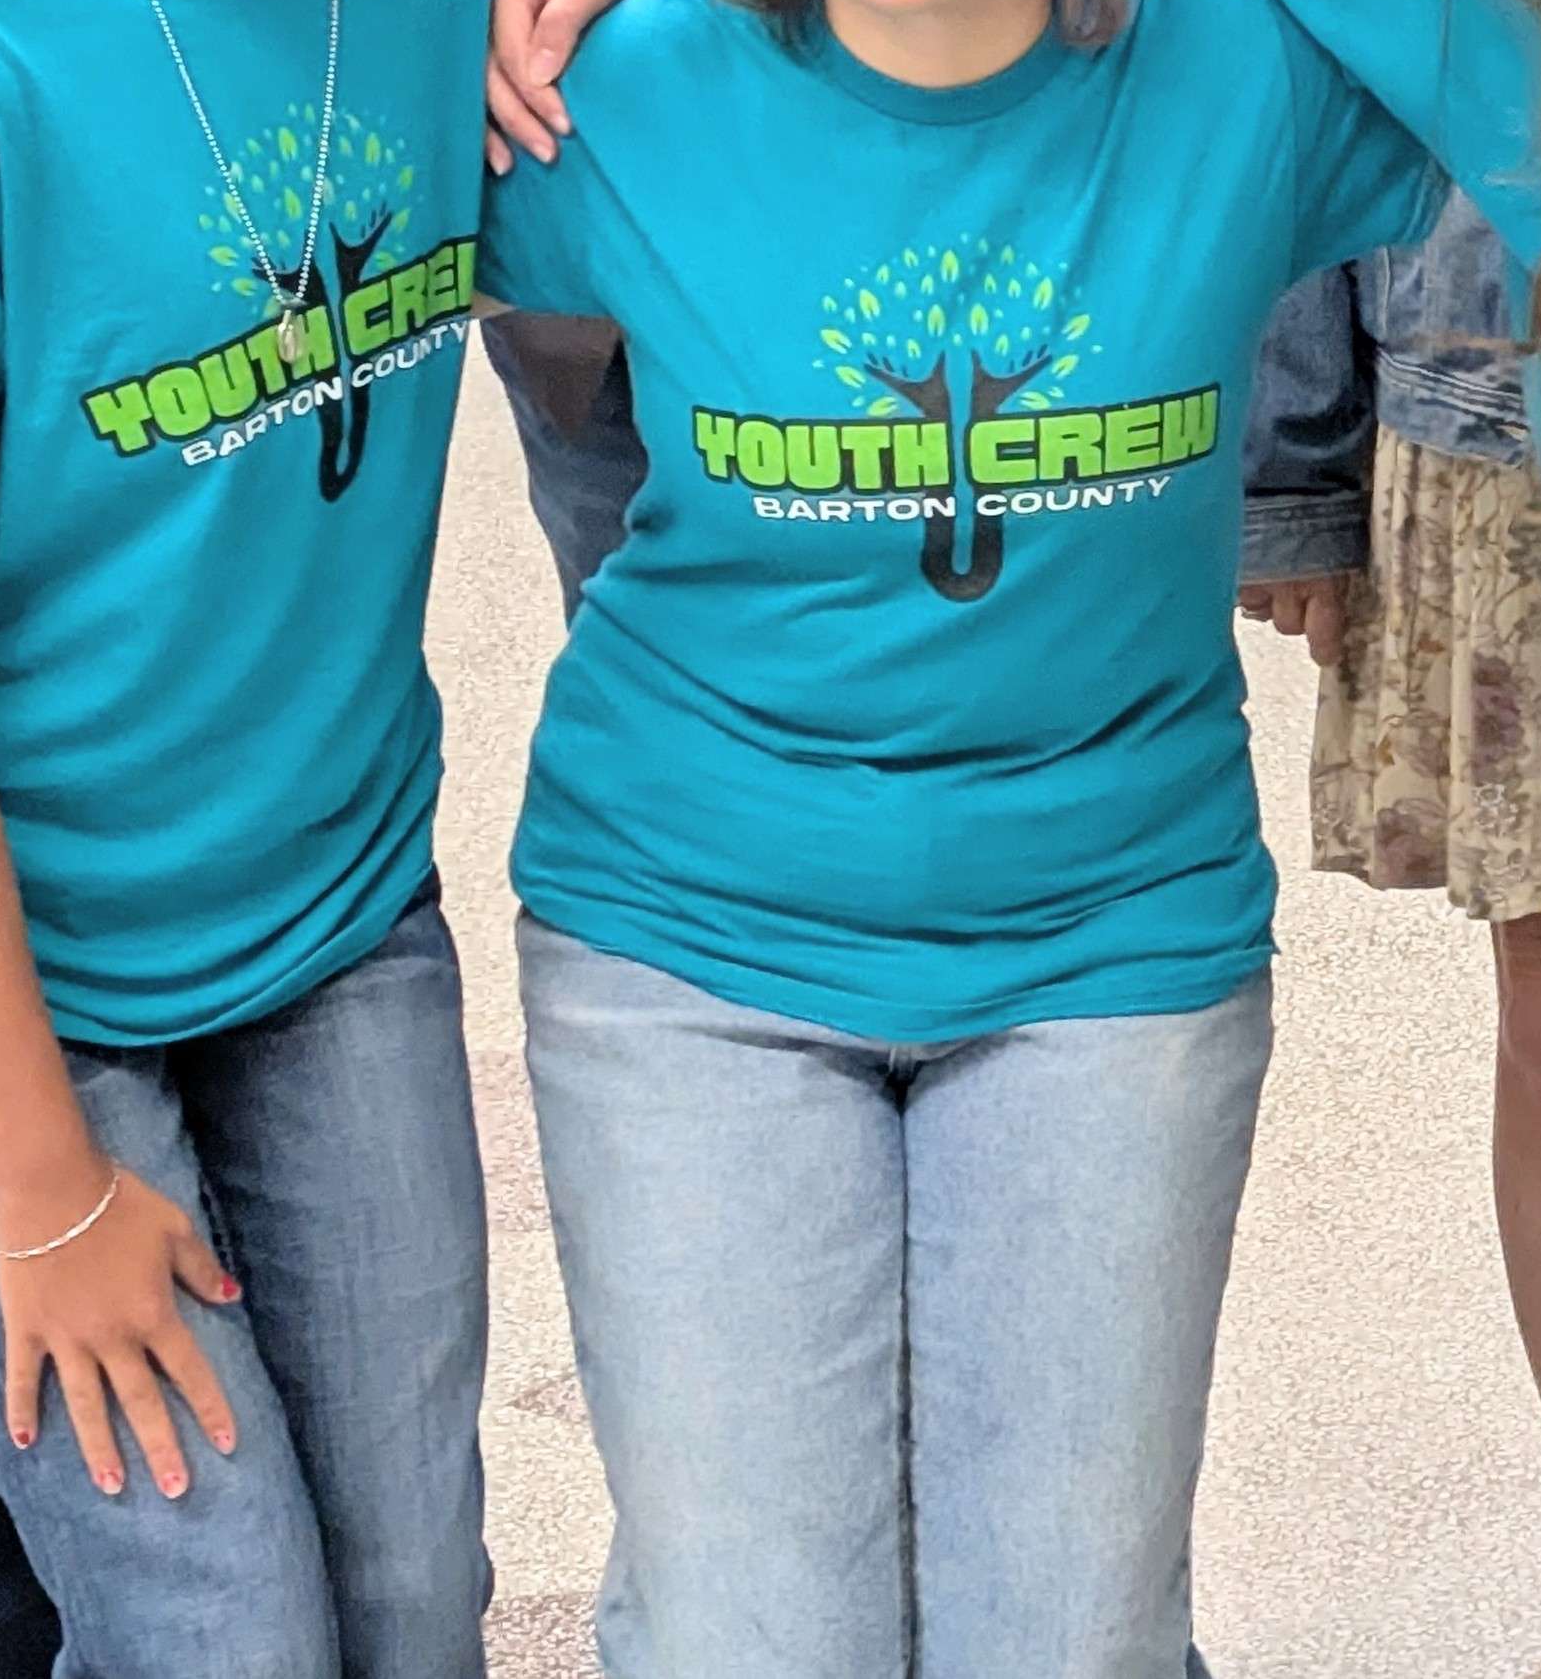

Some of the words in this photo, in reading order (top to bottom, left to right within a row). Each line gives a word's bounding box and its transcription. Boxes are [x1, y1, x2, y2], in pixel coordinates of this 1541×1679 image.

[86, 305, 337, 453] YOUTH
[182, 376, 343, 467] BARTON
[350, 319, 470, 388] COUNTY
[695, 410, 951, 490] YOUTH
[969, 389, 1220, 484] CREW
[753, 495, 956, 522] BARTON
[976, 475, 1172, 518] COUNTY
